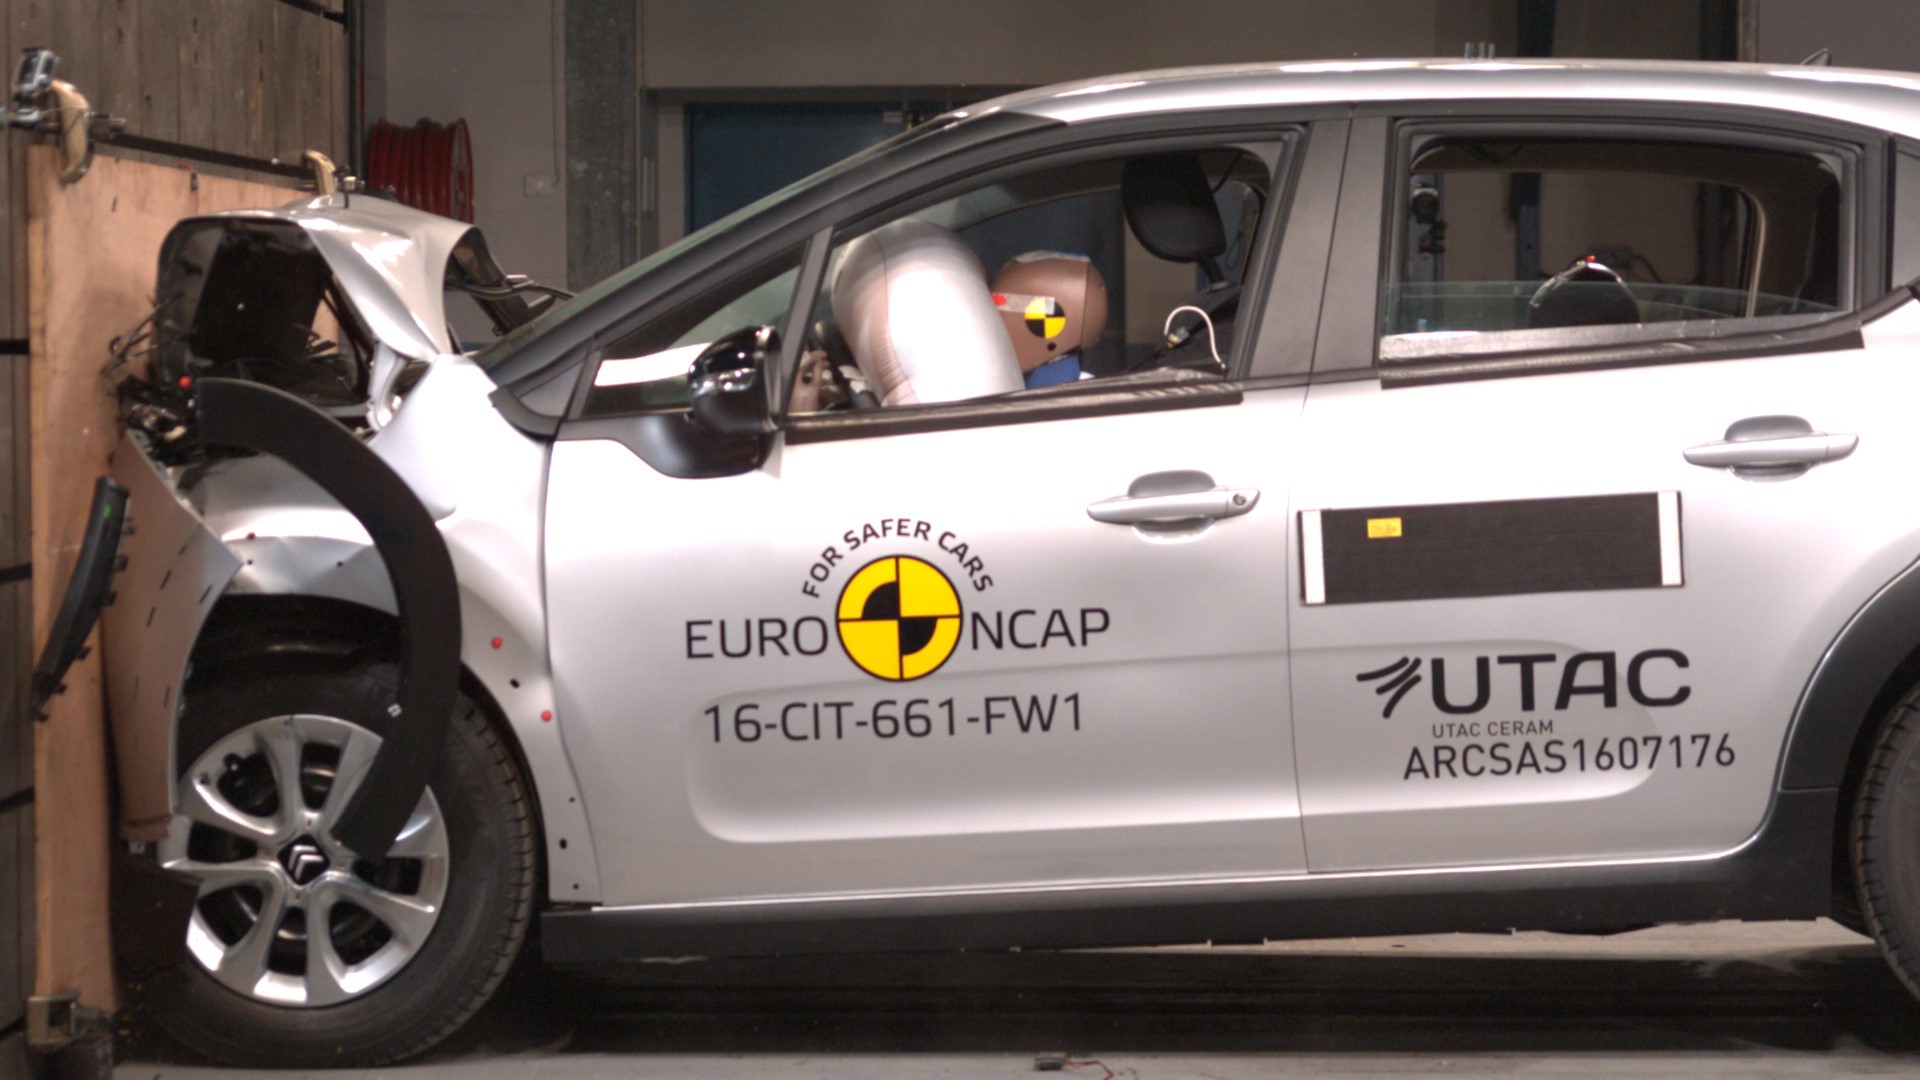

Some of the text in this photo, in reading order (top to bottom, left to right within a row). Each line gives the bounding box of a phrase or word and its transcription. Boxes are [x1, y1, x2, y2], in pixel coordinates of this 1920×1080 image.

[802, 518, 994, 598] FOR SAFER CARS
[686, 607, 1110, 658] EURO NCAP
[1431, 648, 1692, 714] UTAC
[704, 692, 1081, 742] 16-CIT-661-FW1
[1432, 720, 1554, 738] UTAC CERAM
[1404, 733, 1735, 779] ARCSAS1607176
